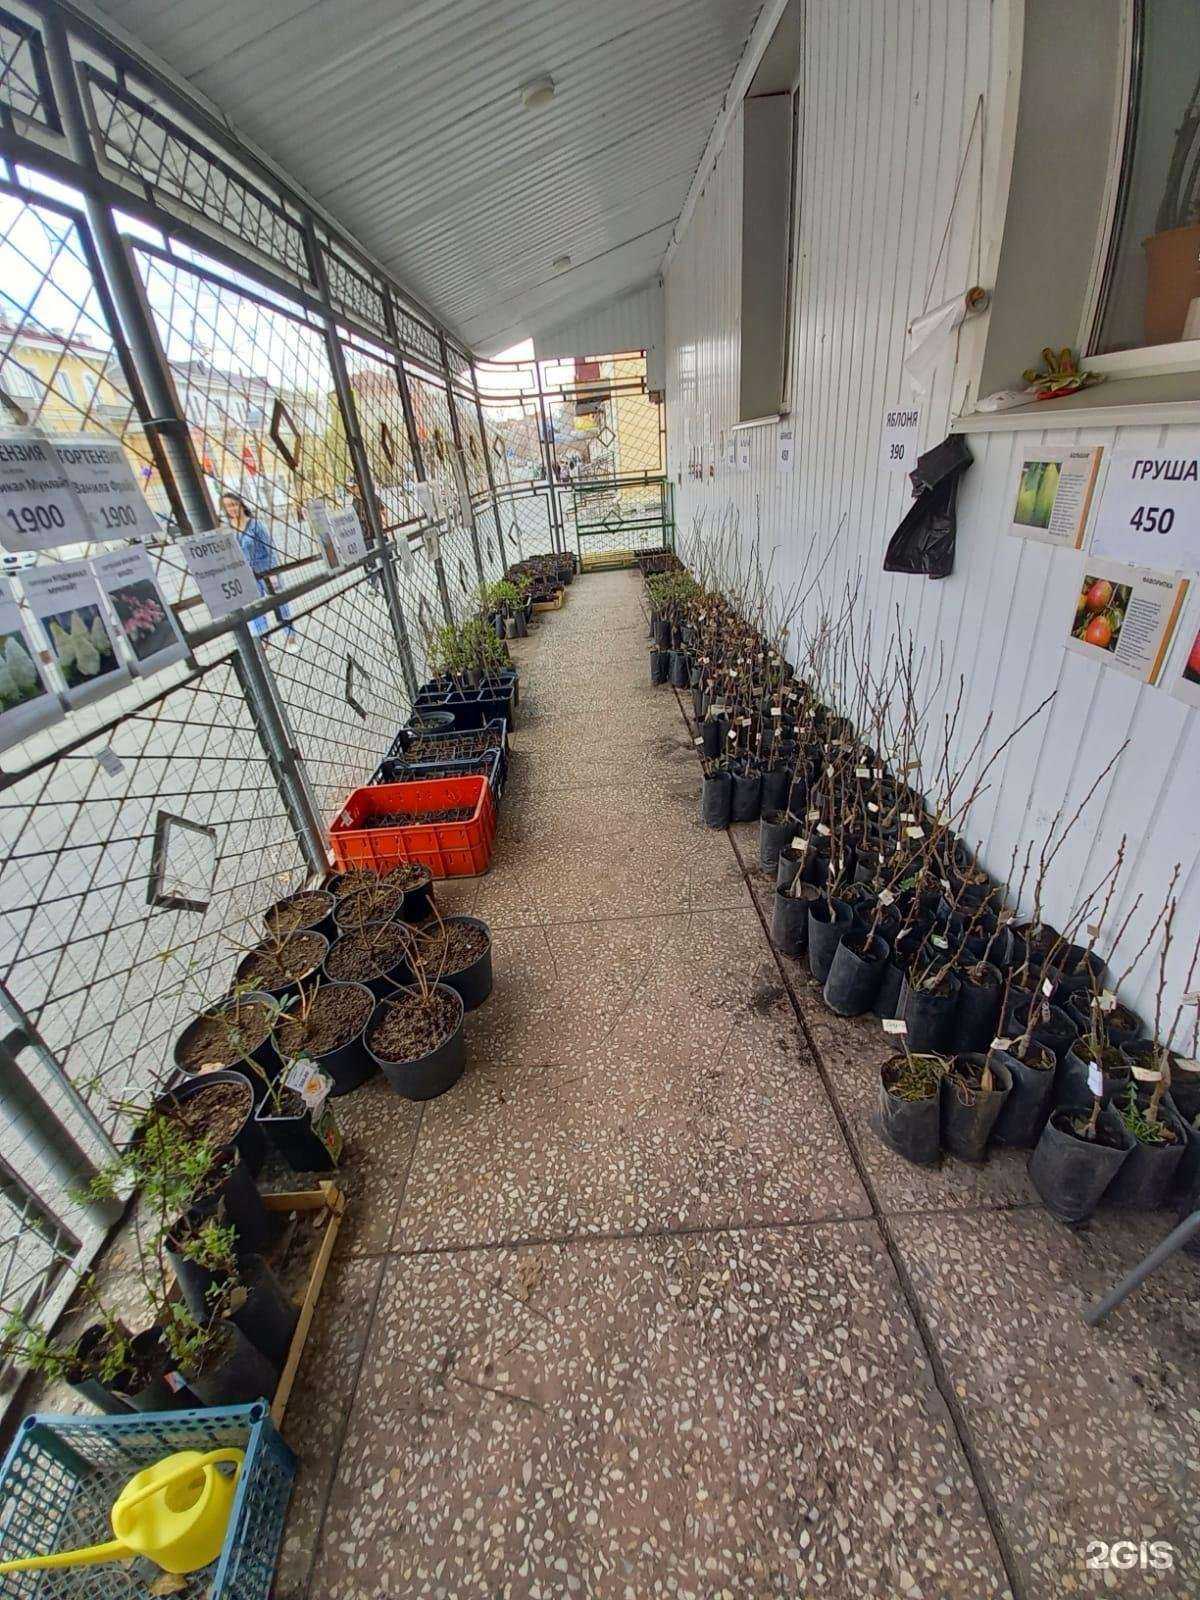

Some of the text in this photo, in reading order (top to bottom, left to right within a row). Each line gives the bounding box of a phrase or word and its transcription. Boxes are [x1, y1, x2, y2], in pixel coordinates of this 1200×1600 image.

[886, 411, 918, 427] ЯБЛОНЯ
[890, 443, 905, 460] 390
[1131, 460, 1198, 481] ГРУША
[7, 504, 65, 534] 1900
[100, 505, 138, 530] 1900
[1129, 506, 1175, 535] 450
[221, 578, 243, 599] 550
